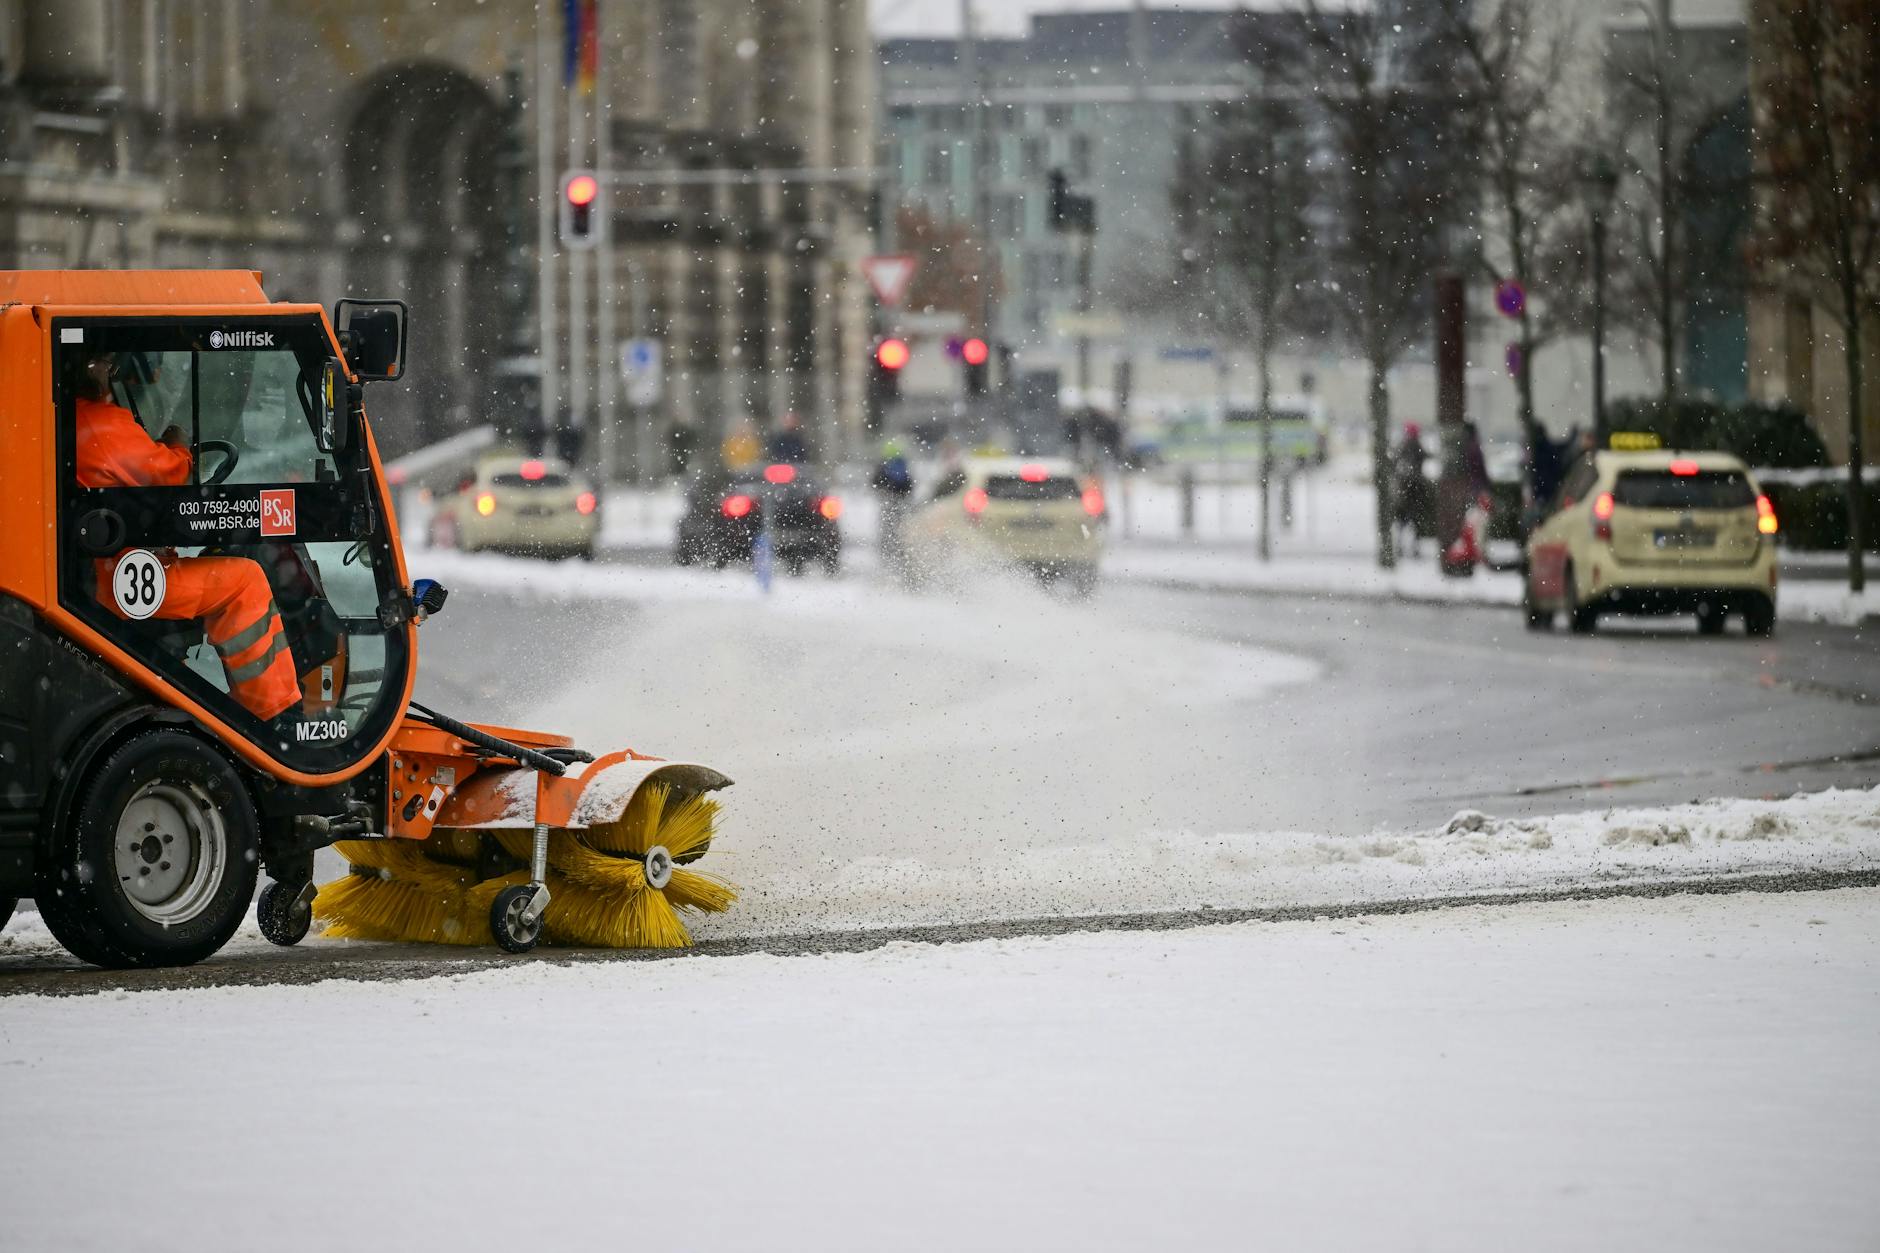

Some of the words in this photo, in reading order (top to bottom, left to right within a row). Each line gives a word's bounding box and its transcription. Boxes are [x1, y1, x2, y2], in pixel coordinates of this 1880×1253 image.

[224, 331, 275, 347] Nilfisk
[179, 502, 200, 516] 030
[202, 499, 260, 515] 7592-4900
[263, 498, 292, 527] BSR
[190, 515, 260, 531] www.BSR.de
[124, 562, 156, 606] 38
[296, 719, 348, 742] MZ306
